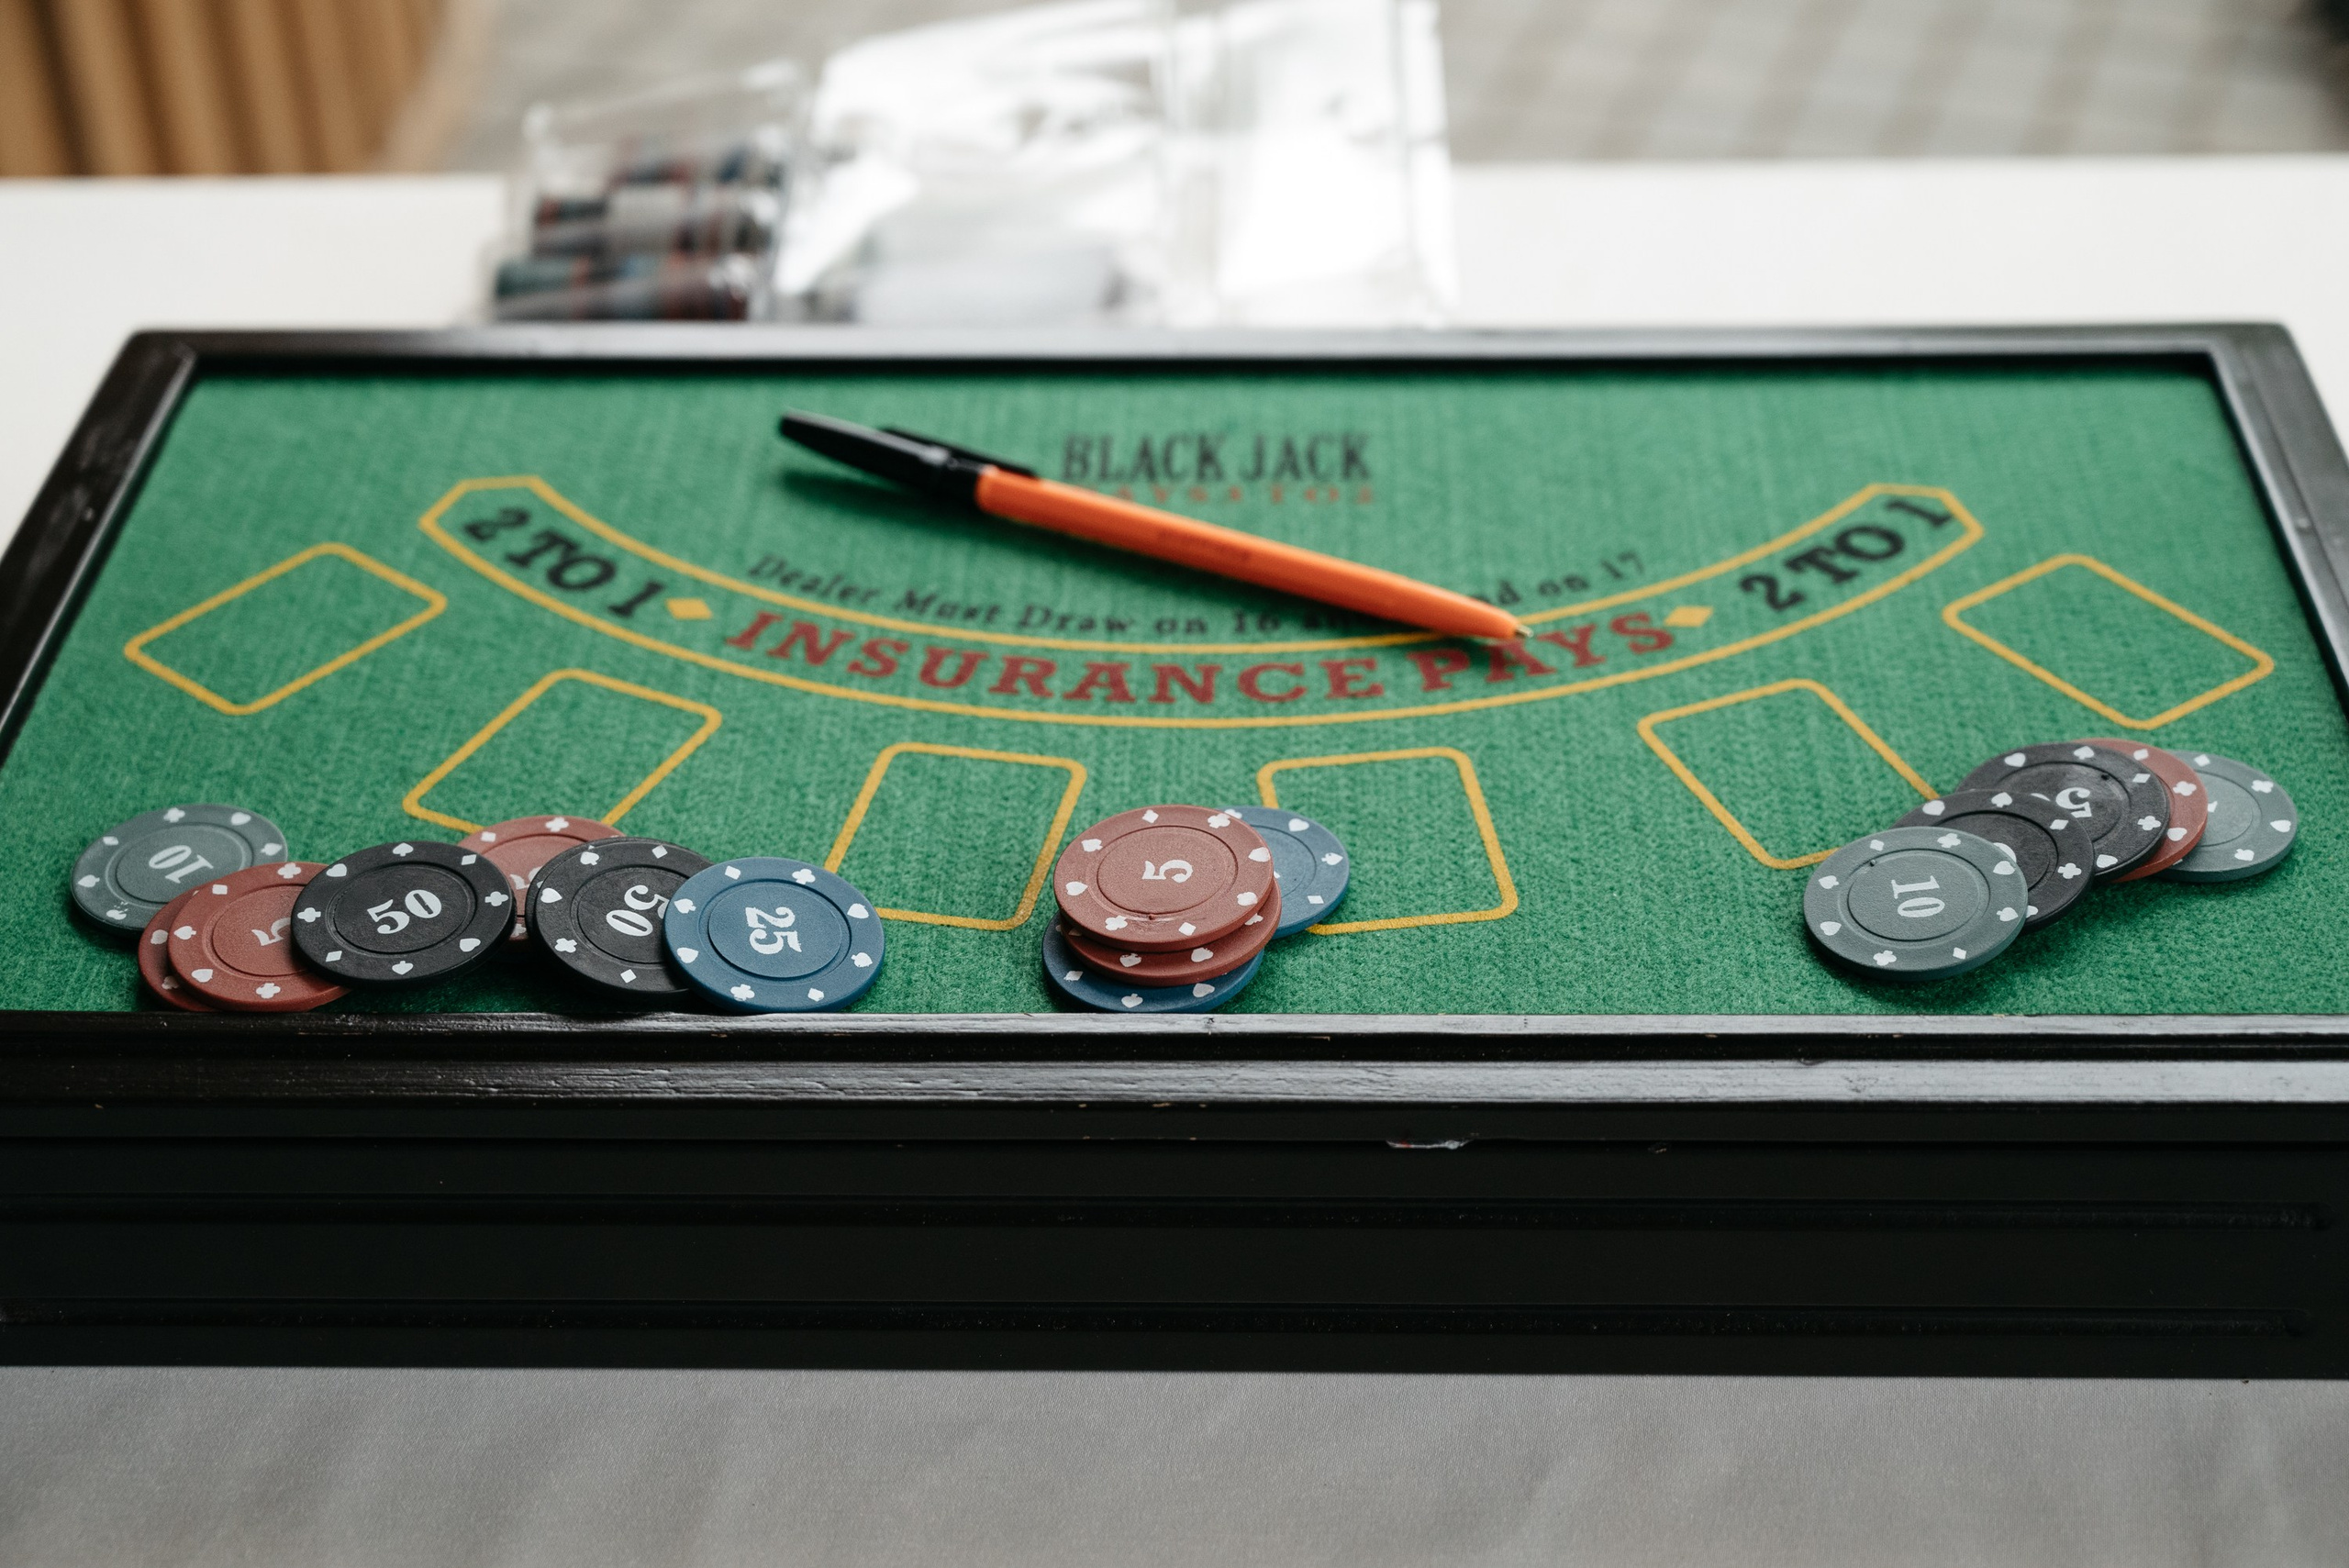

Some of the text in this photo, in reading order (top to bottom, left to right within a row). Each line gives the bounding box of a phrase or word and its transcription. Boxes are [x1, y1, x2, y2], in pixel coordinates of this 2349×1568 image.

[1062, 431, 1375, 483] BLACK JACK
[462, 507, 532, 543] 2
[506, 526, 618, 592] TO
[725, 611, 1384, 704] INSURANCE
[1407, 612, 1675, 692] PAYS
[1739, 573, 1807, 612] 2
[1783, 524, 1906, 584] TO
[747, 552, 879, 605] Dealer
[892, 587, 1002, 625] Must
[1016, 603, 1135, 635] Draw
[1153, 616, 1208, 635] on
[1234, 607, 1281, 633] 16
[1600, 550, 1647, 581] 17
[148, 844, 215, 884] 10
[1141, 859, 1194, 884] 5
[367, 889, 442, 935] 50
[1890, 875, 1946, 918] 10
[744, 906, 803, 955] 25
